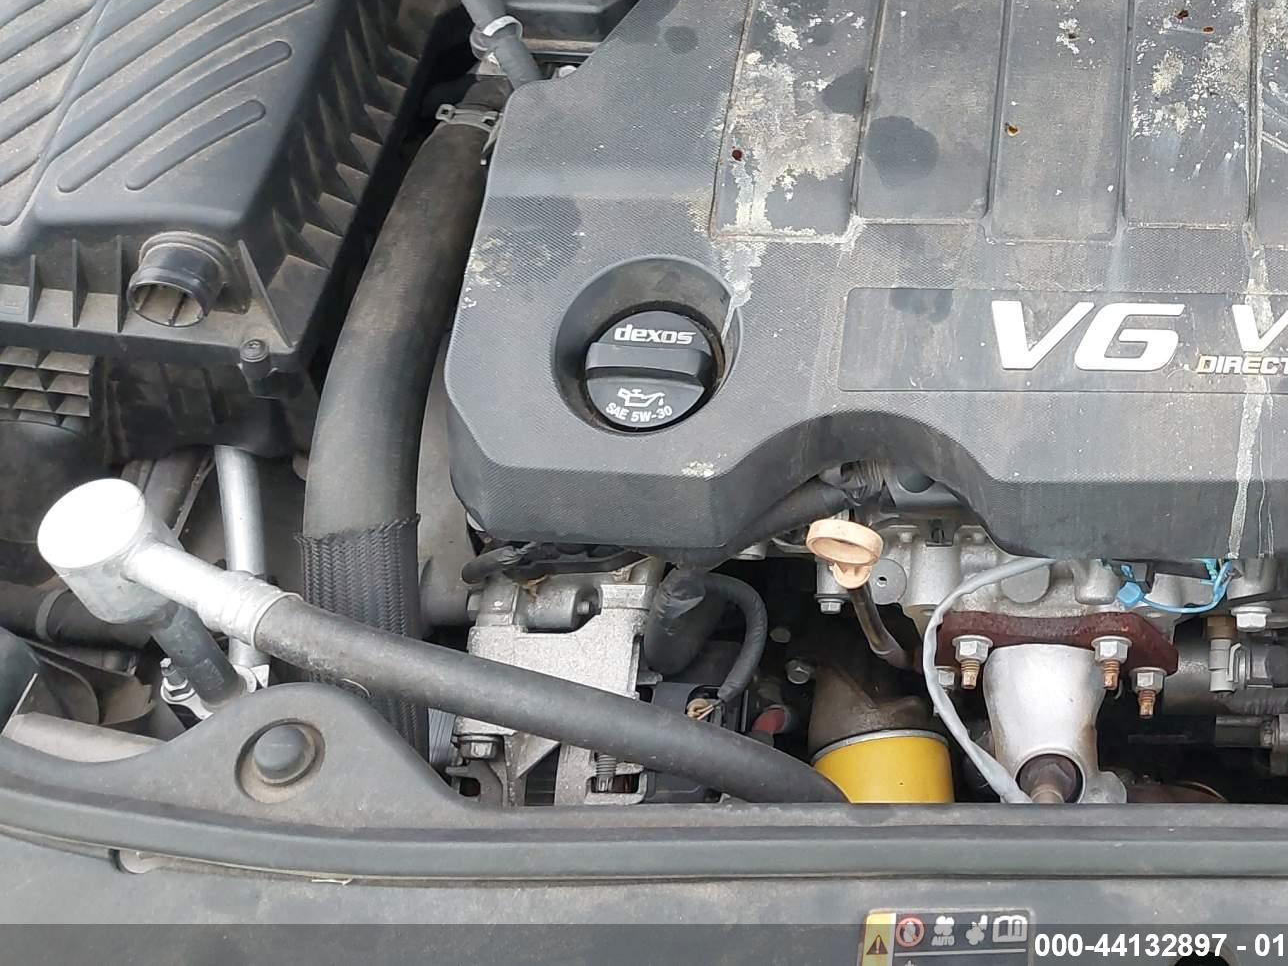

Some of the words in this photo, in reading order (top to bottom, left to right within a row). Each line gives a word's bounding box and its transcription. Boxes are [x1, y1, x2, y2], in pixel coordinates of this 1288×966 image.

[613, 323, 697, 345] dexos
[991, 299, 1187, 372] V6
[605, 401, 630, 422] SAE
[630, 404, 673, 423] 5W-30
[931, 935, 956, 947] AUTO
